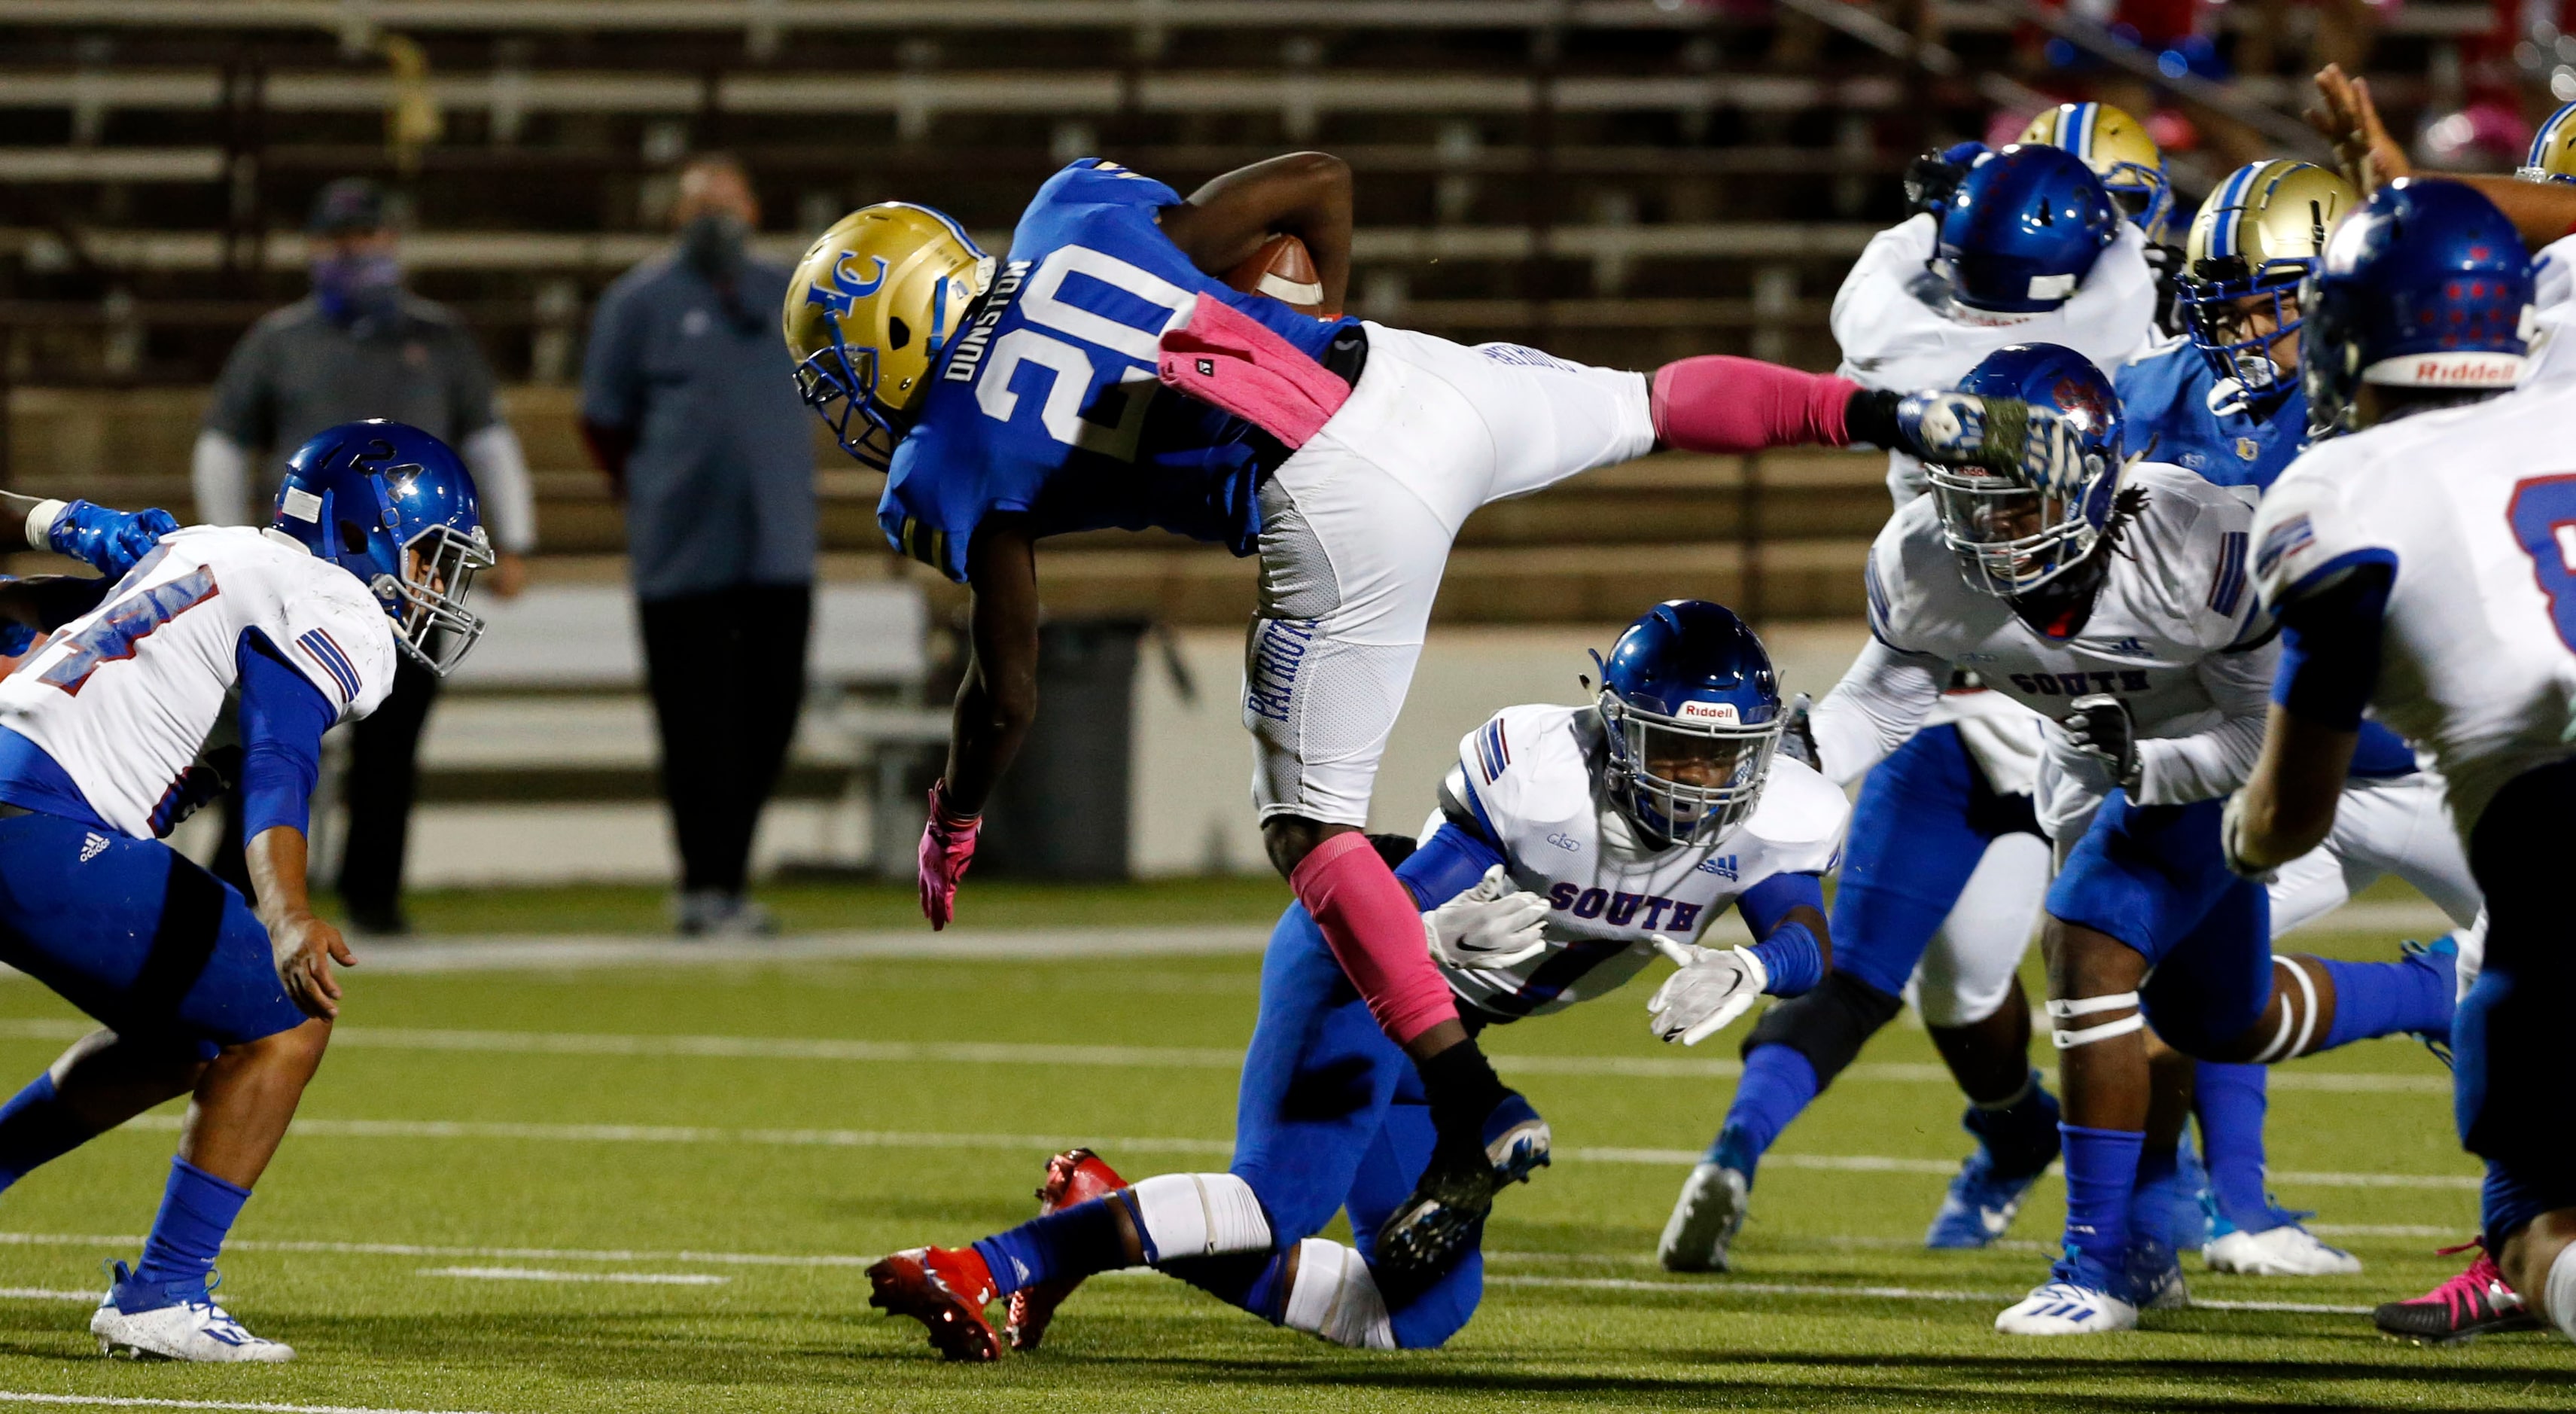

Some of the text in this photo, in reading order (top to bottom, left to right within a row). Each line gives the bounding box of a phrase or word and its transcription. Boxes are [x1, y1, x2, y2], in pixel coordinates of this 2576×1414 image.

[944, 260, 1032, 382] DUNSTON
[976, 243, 1198, 463] 20
[2415, 361, 2517, 381] Riddell
[348, 439, 425, 504] 24
[2008, 668, 2151, 696] SOUTH
[1686, 705, 1733, 718] Riddell
[80, 837, 111, 862] adidas
[1697, 863, 1739, 882] adidas
[1542, 882, 1704, 932] SOUTH
